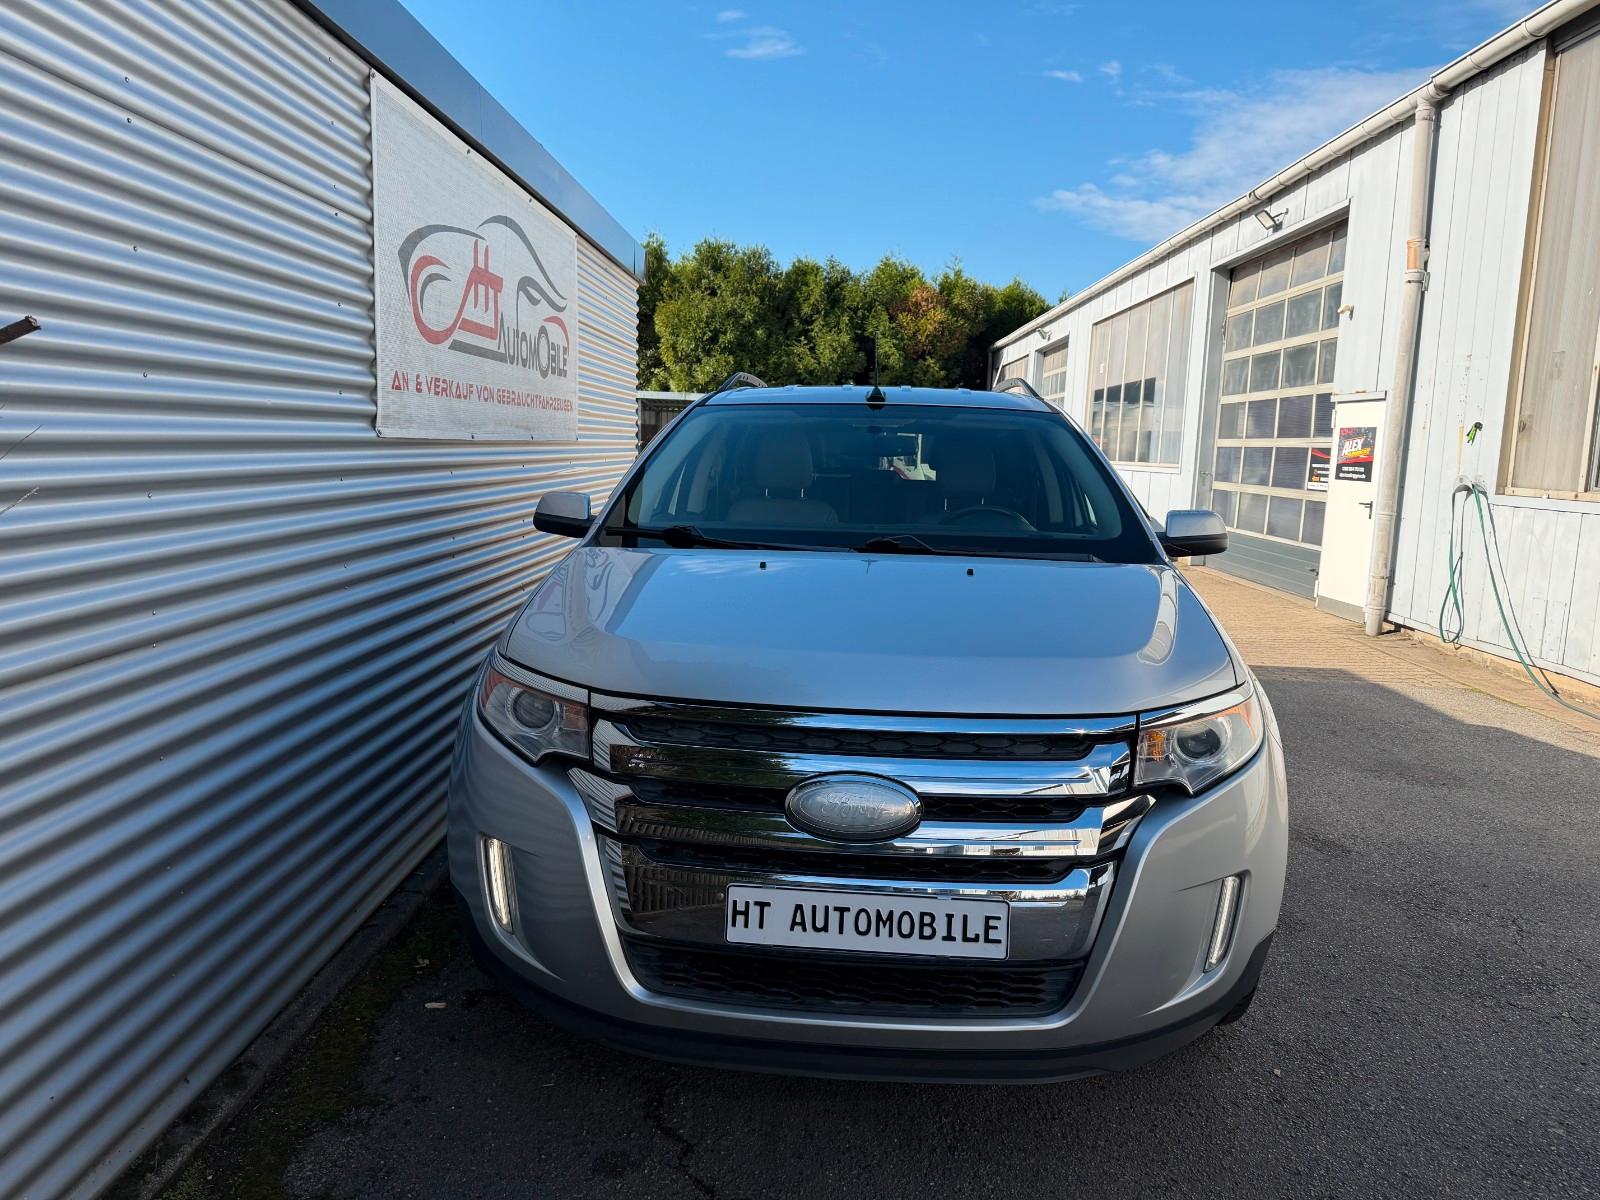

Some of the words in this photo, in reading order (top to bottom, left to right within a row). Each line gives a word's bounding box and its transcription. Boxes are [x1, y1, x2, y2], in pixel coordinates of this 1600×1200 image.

[391, 370, 409, 392] AN
[415, 373, 423, 393] &
[425, 375, 474, 400] VERKAUF
[476, 384, 495, 404] VON
[496, 388, 574, 413] GEBRAUCHTFAHRZEUGEN
[1342, 436, 1366, 457] ALEX
[731, 899, 771, 930] HT
[789, 903, 1003, 945] AUTOMOBILE
